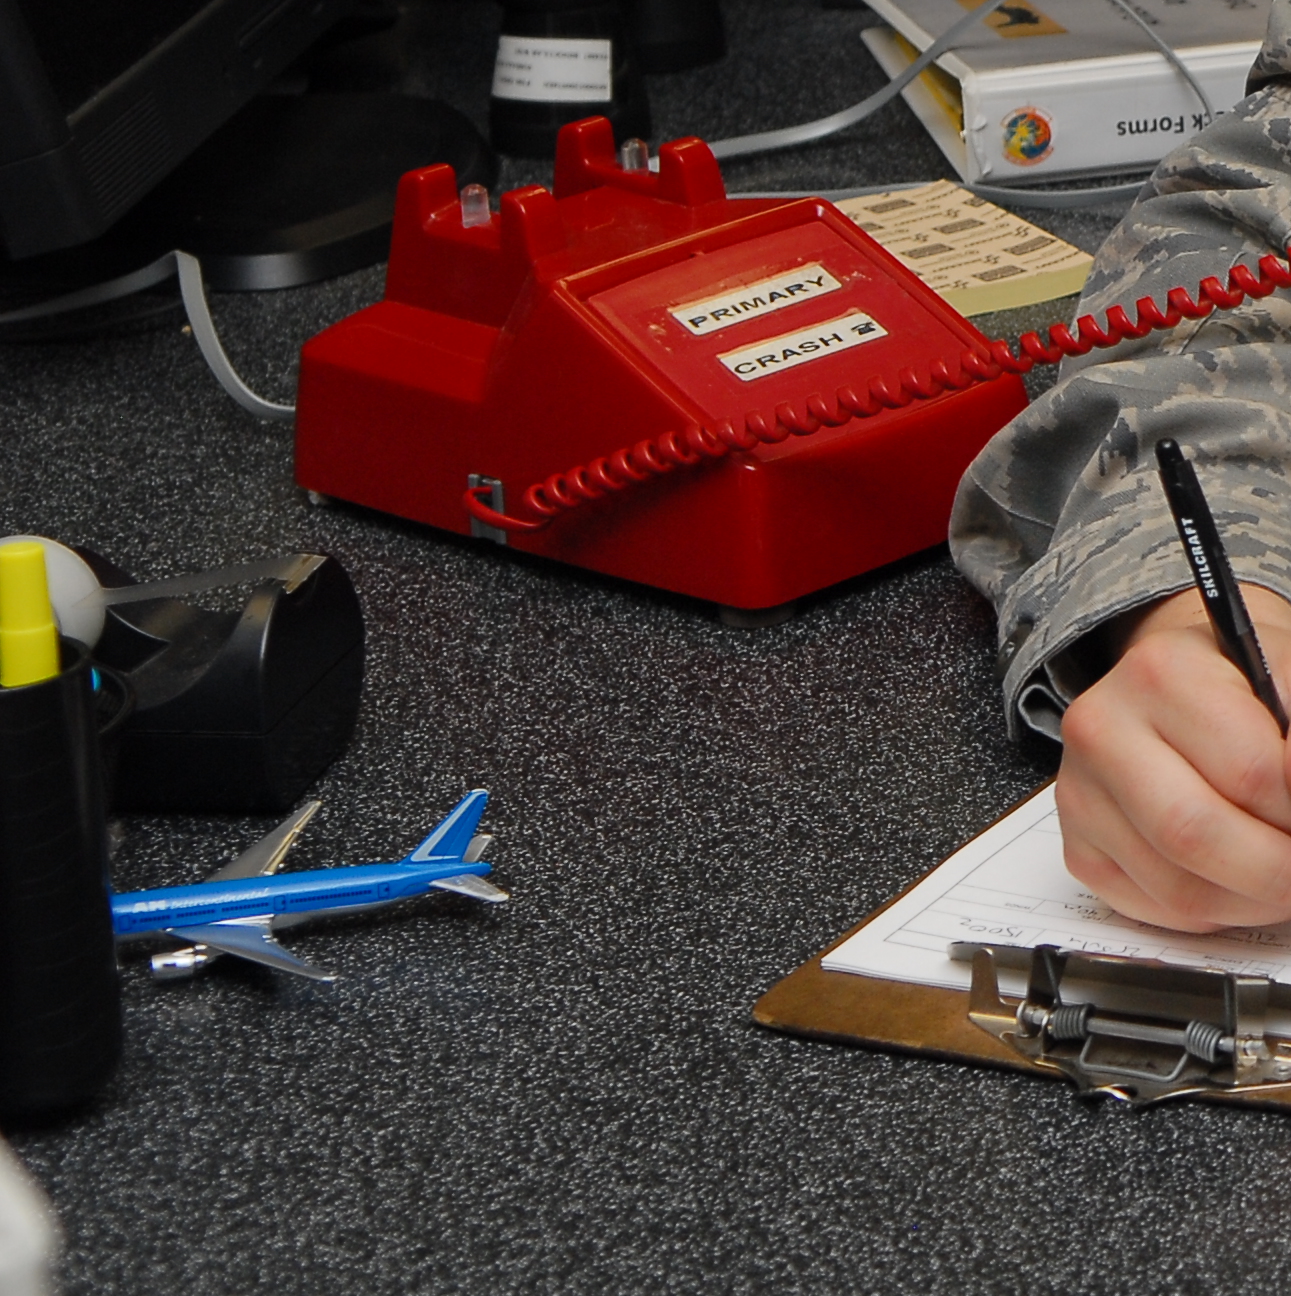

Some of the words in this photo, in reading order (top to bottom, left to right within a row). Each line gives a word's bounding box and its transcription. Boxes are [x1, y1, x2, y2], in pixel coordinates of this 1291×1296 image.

[1116, 115, 1184, 136] Forms
[688, 275, 824, 328] PRIMARY
[734, 333, 844, 374] CRASH
[1182, 517, 1219, 598] SKILCRAFT
